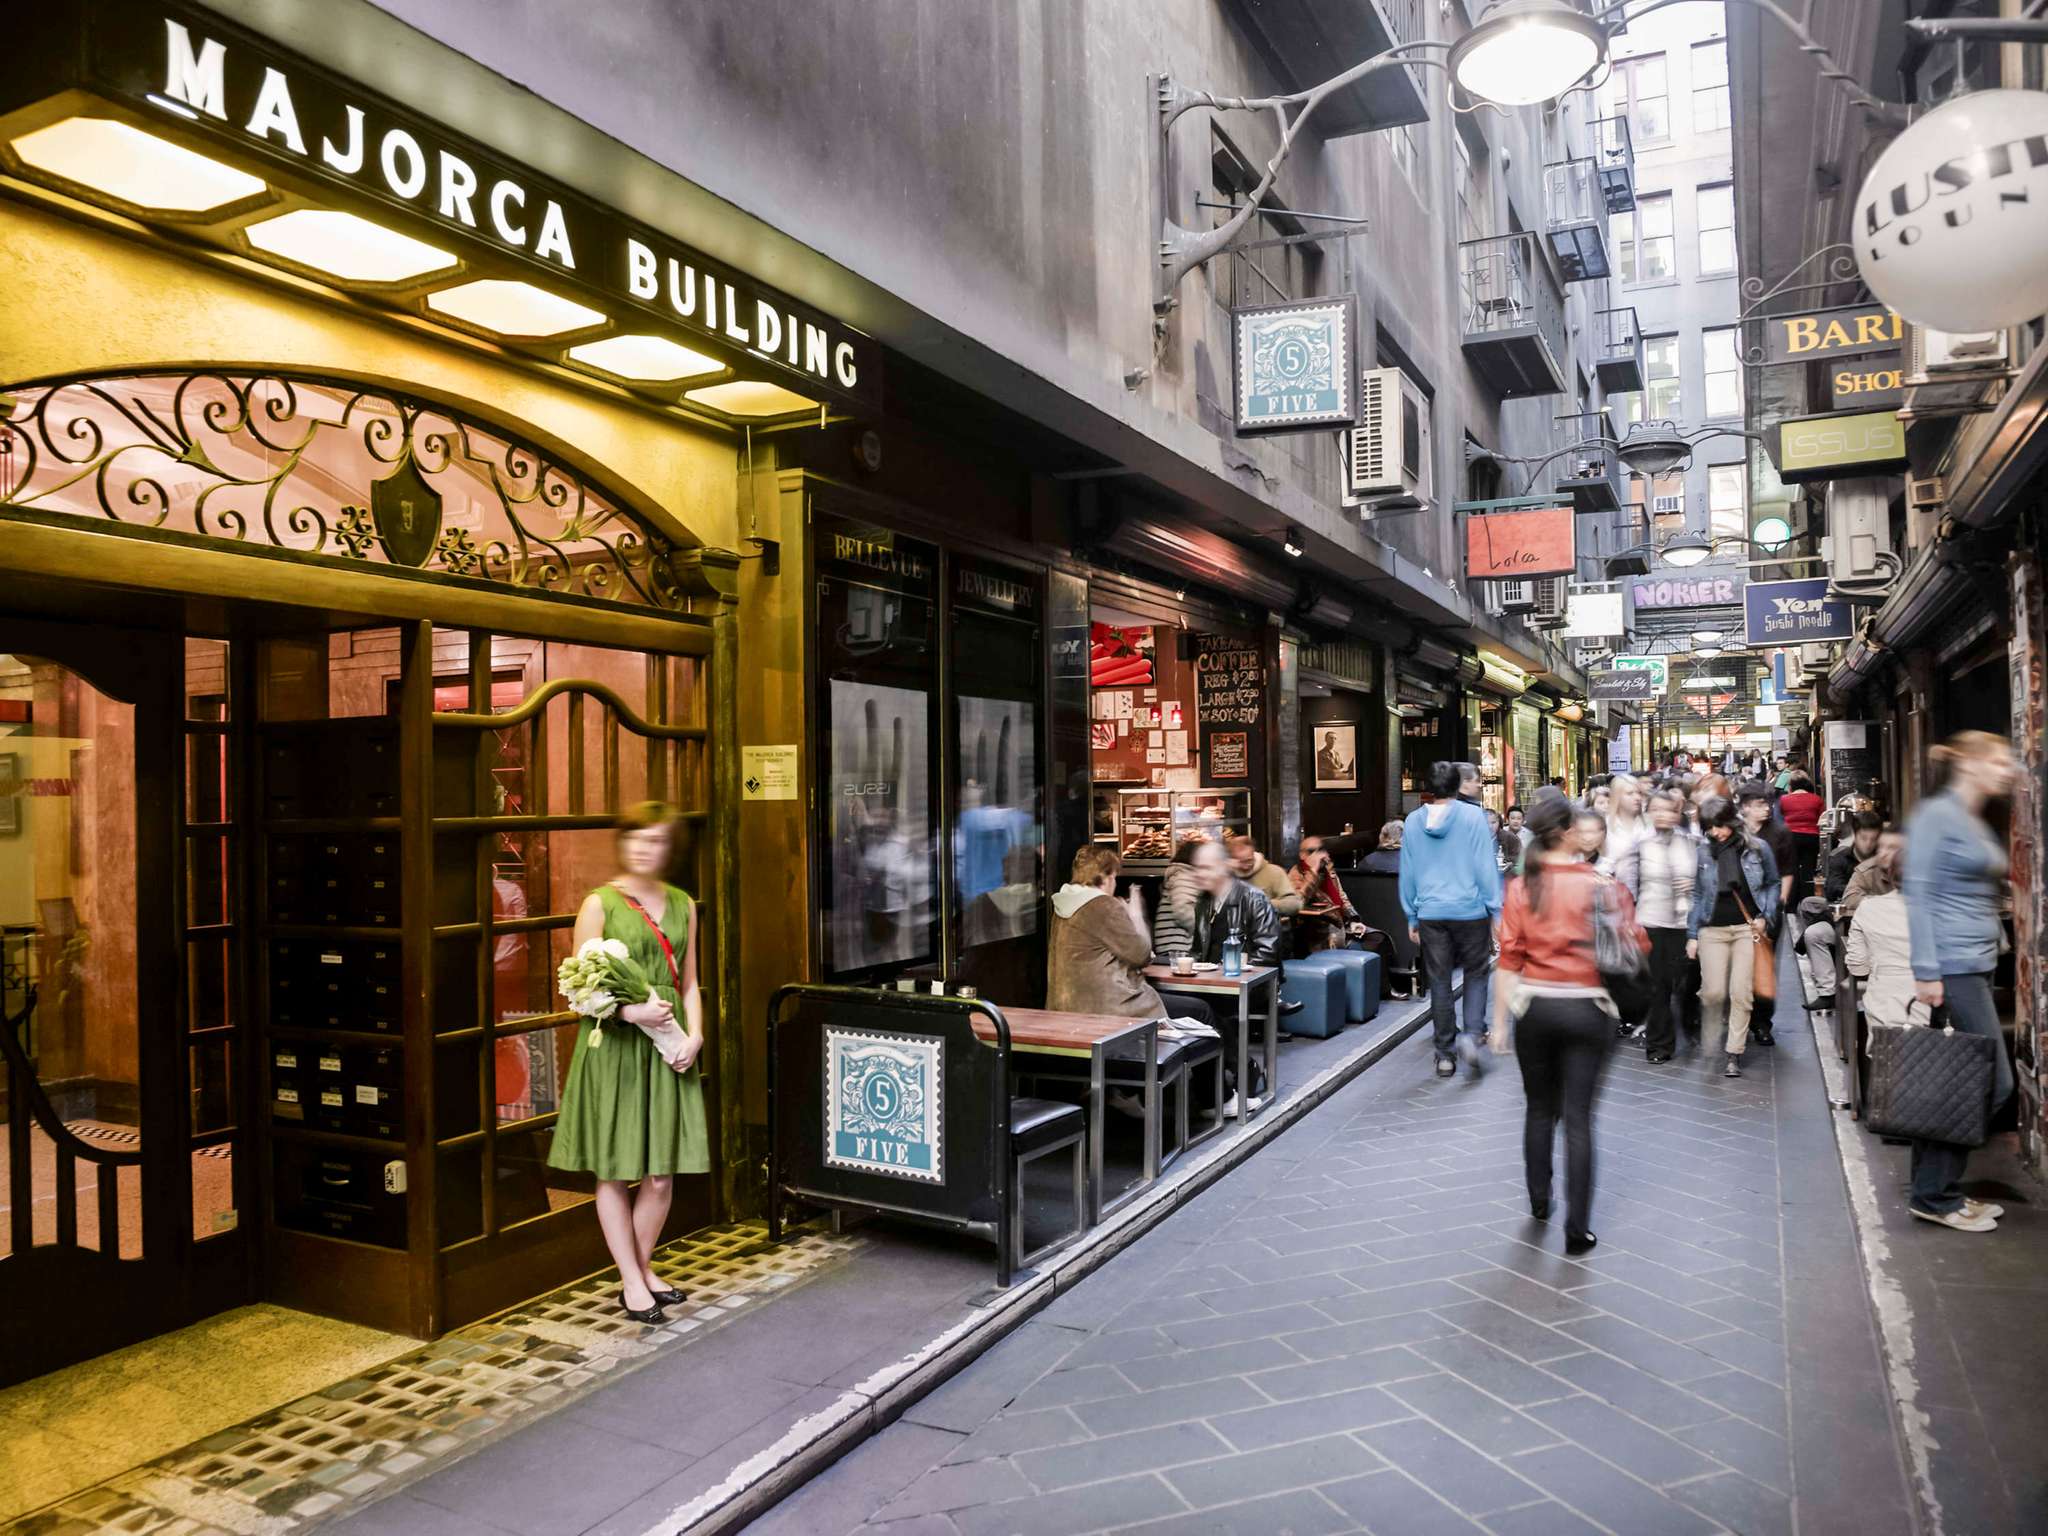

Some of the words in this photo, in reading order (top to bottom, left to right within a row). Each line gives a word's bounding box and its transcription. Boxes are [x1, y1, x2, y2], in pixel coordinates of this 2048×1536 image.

[165, 17, 576, 269] MAJORCA
[628, 237, 857, 388] BUILDING
[1286, 346, 1300, 372] 5
[1268, 392, 1318, 414] FIVE
[834, 533, 923, 581] BELLEVUE
[957, 568, 1034, 609] JEWELLERY
[1770, 597, 1824, 615] Yen
[1765, 614, 1793, 632] Sushi
[1199, 650, 1259, 672] COFFEE
[1204, 674, 1229, 689] REG
[1210, 707, 1234, 723] SOY
[875, 1080, 891, 1112] 5
[856, 1136, 910, 1165] FIVE
